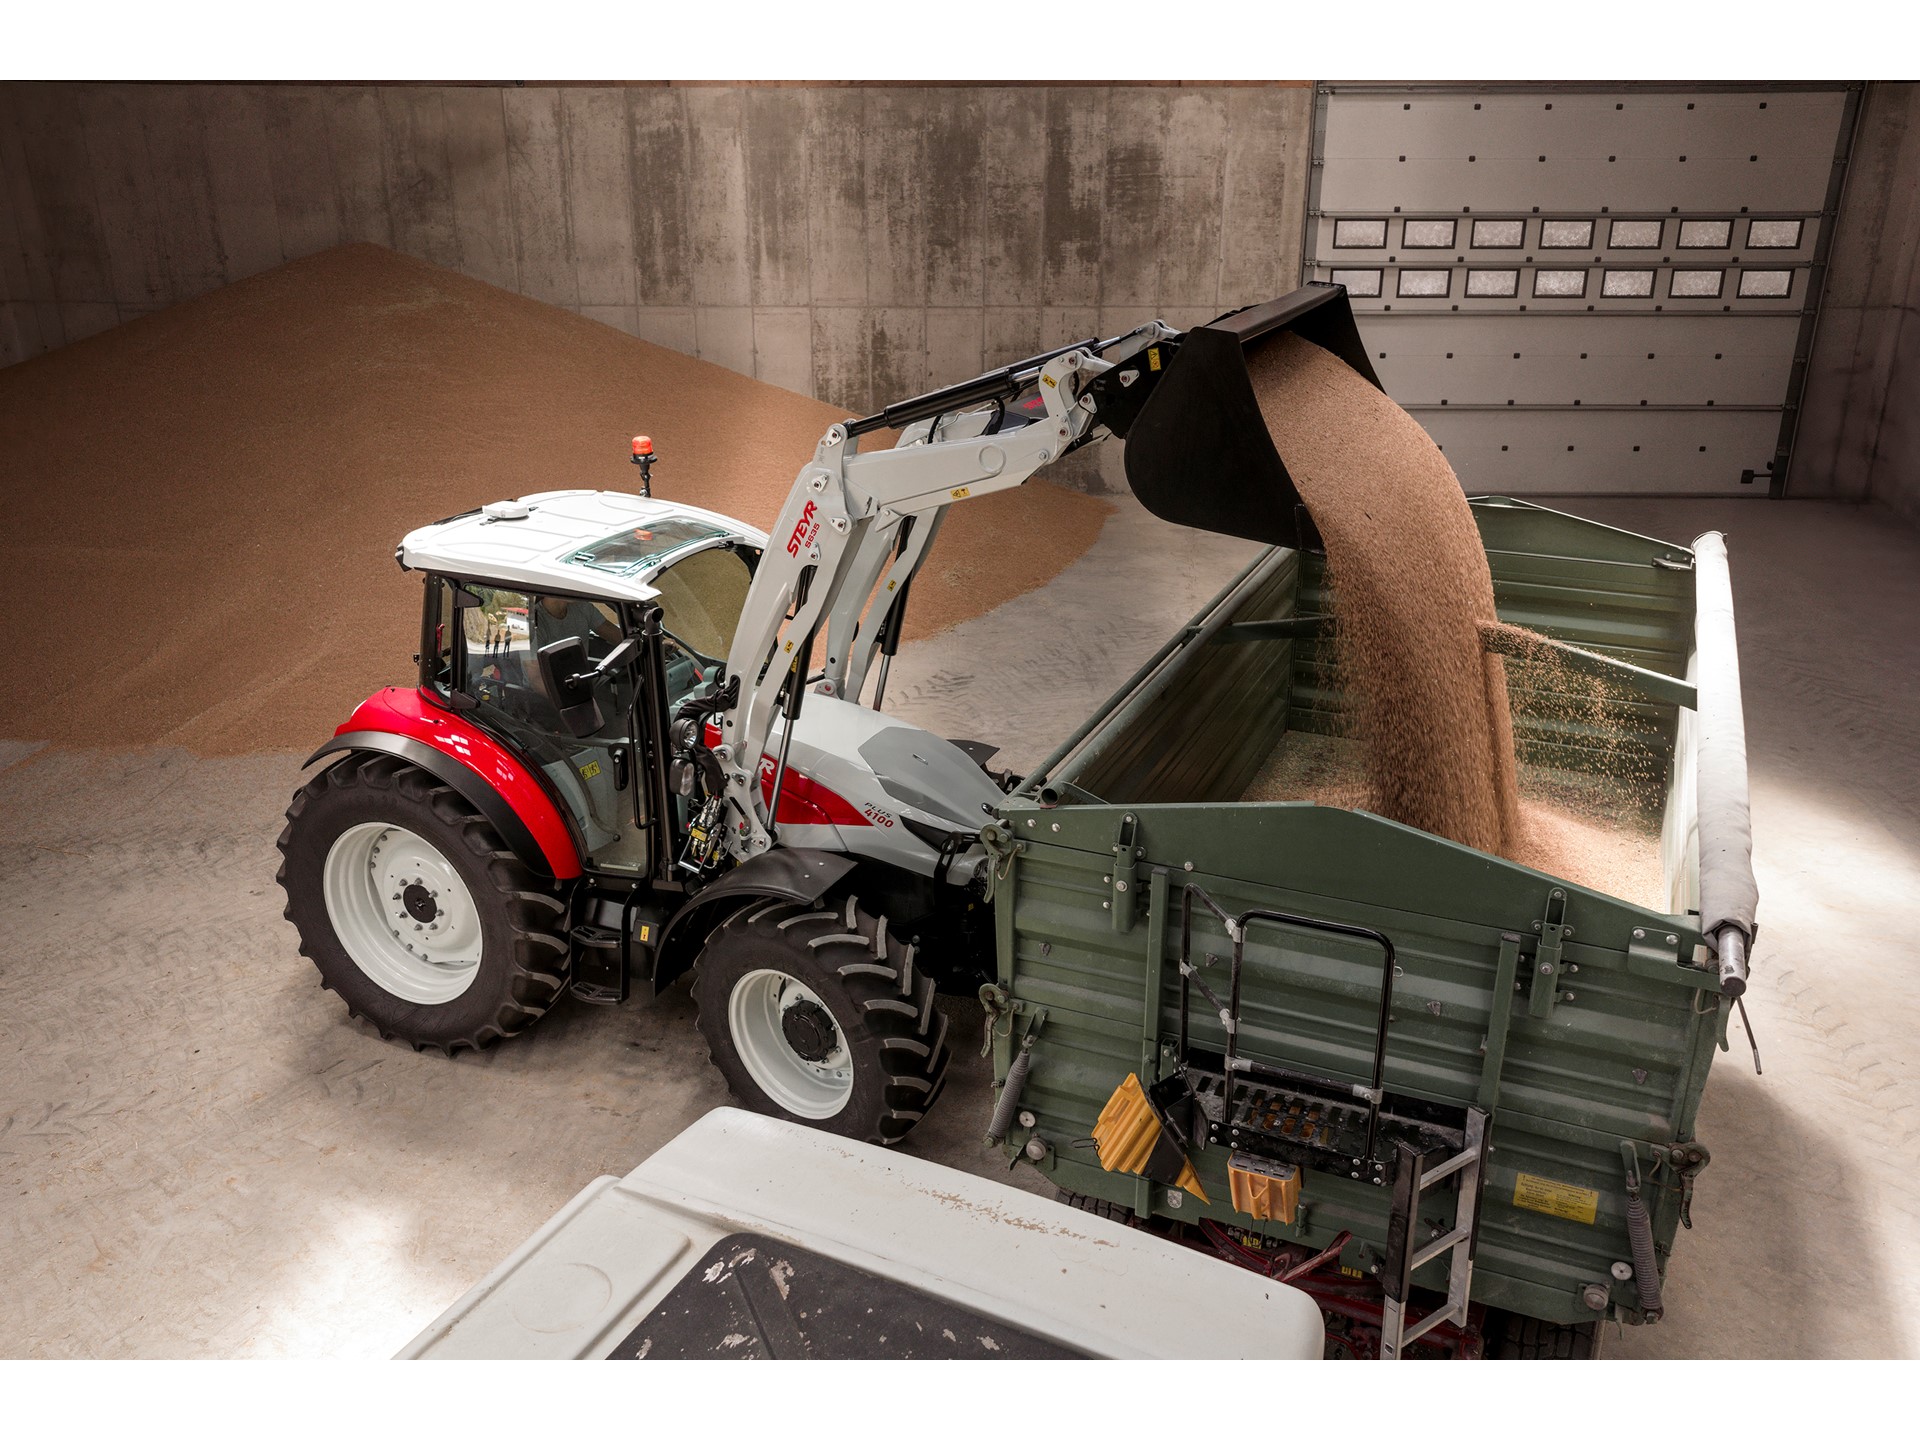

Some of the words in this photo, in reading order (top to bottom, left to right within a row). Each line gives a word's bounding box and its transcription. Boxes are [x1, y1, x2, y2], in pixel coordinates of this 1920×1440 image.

[787, 500, 818, 559] STEYR
[804, 522, 821, 549] S635
[864, 802, 893, 818] PLUS
[864, 808, 894, 828] 4100
